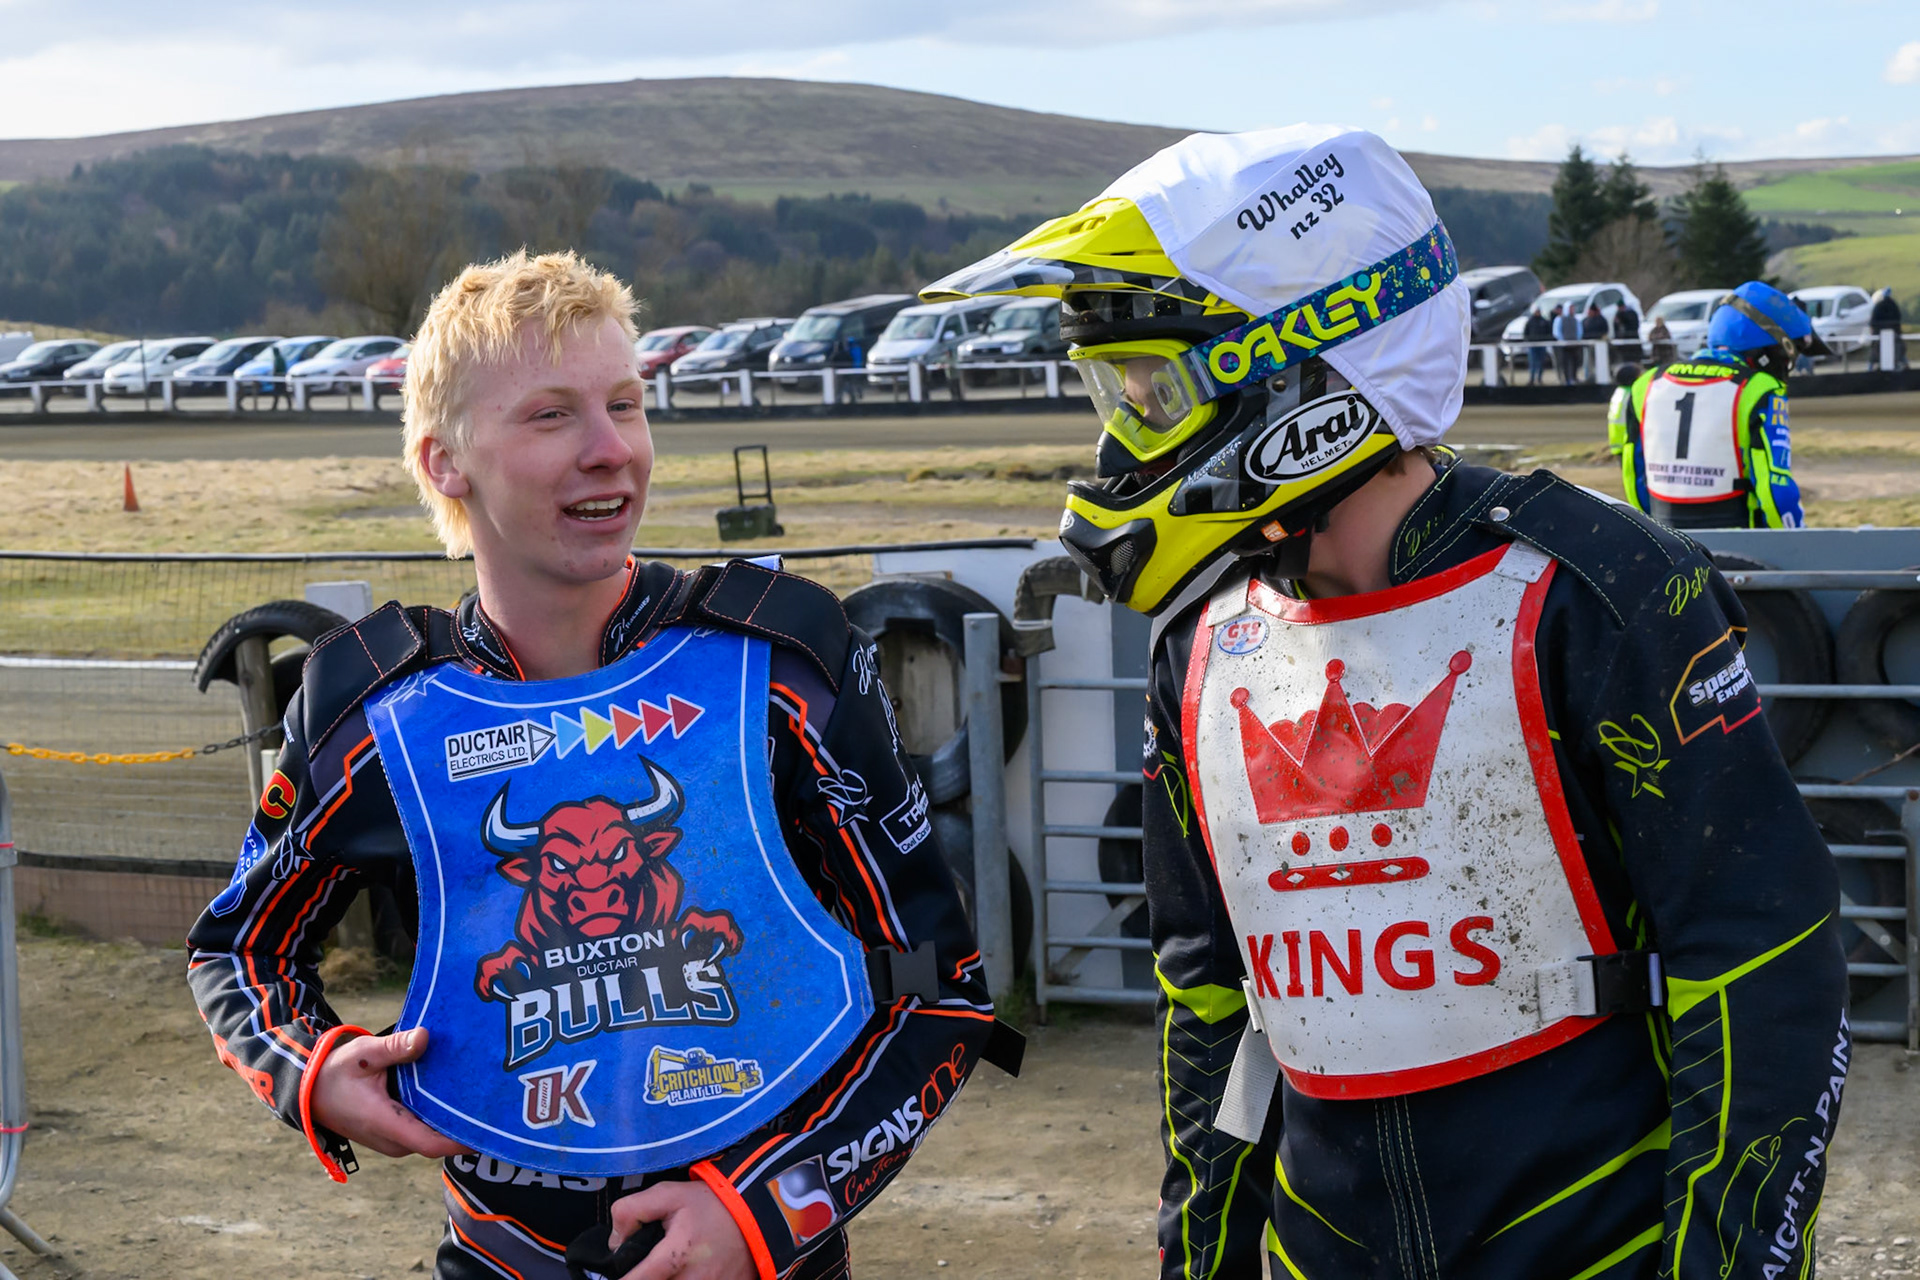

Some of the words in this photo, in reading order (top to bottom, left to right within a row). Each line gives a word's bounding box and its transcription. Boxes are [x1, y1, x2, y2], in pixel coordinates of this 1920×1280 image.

[1237, 153, 1344, 231] Whalley
[1290, 210, 1319, 240] nz
[1311, 183, 1344, 214] 32
[1209, 272, 1382, 384] OAKLEY
[1264, 395, 1365, 476] Arai
[1675, 392, 1696, 460] 1
[1301, 442, 1349, 470] HELMET
[1228, 620, 1261, 640] GTS
[448, 725, 527, 757] DUCTAIR
[450, 750, 506, 771] ELECTRICS
[507, 746, 529, 759] LTD.
[544, 929, 665, 969] BUXTON
[577, 956, 638, 977] DUCTAIR
[1247, 916, 1501, 999] KINGS
[507, 958, 735, 1067] BULLS
[526, 1066, 590, 1125] UK
[658, 1062, 736, 1094] CRITCHLOW
[670, 1087, 702, 1102] PLANT
[704, 1084, 722, 1096] LTD
[827, 1095, 924, 1184] SIGNS
